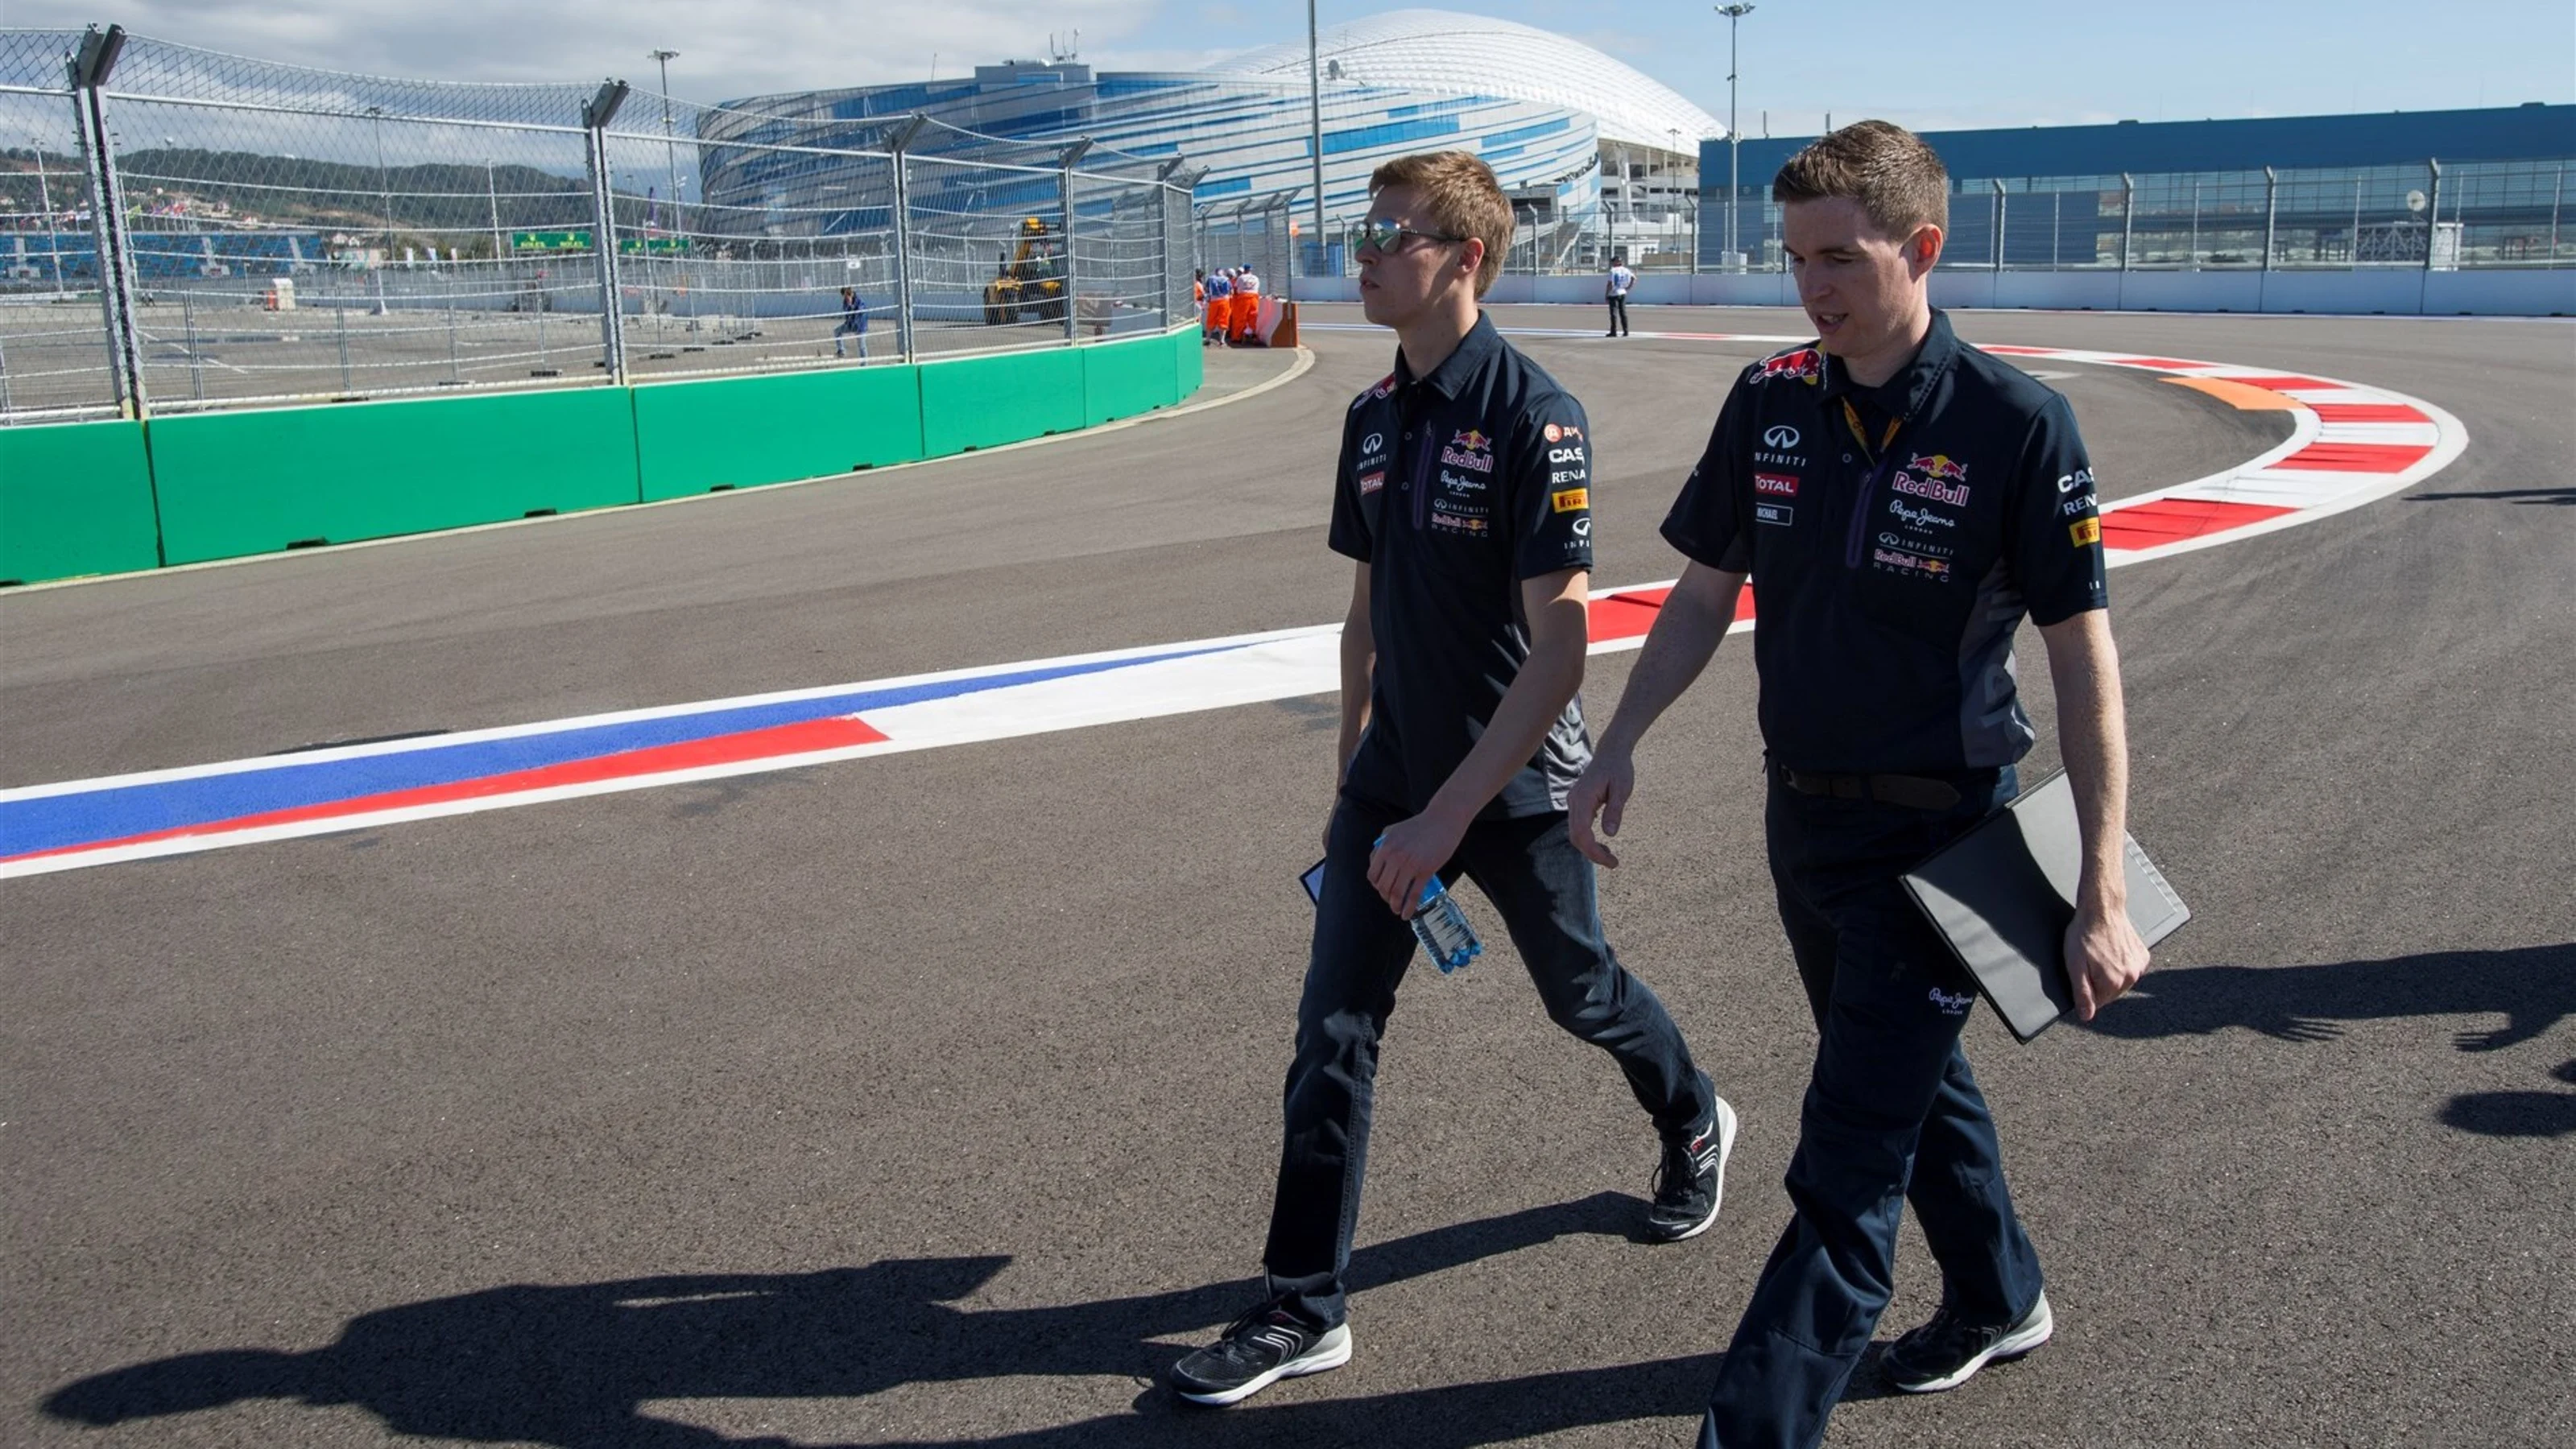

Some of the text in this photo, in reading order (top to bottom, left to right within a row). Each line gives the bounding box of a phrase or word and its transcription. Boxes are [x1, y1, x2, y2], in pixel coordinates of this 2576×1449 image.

[1755, 475, 1794, 493] TOTAL
[1889, 499, 1956, 528] Pepe Jeans
[1901, 539, 1954, 556] INFINITI
[1873, 561, 1950, 583] RACING
[1929, 987, 1953, 1008] Pepe
